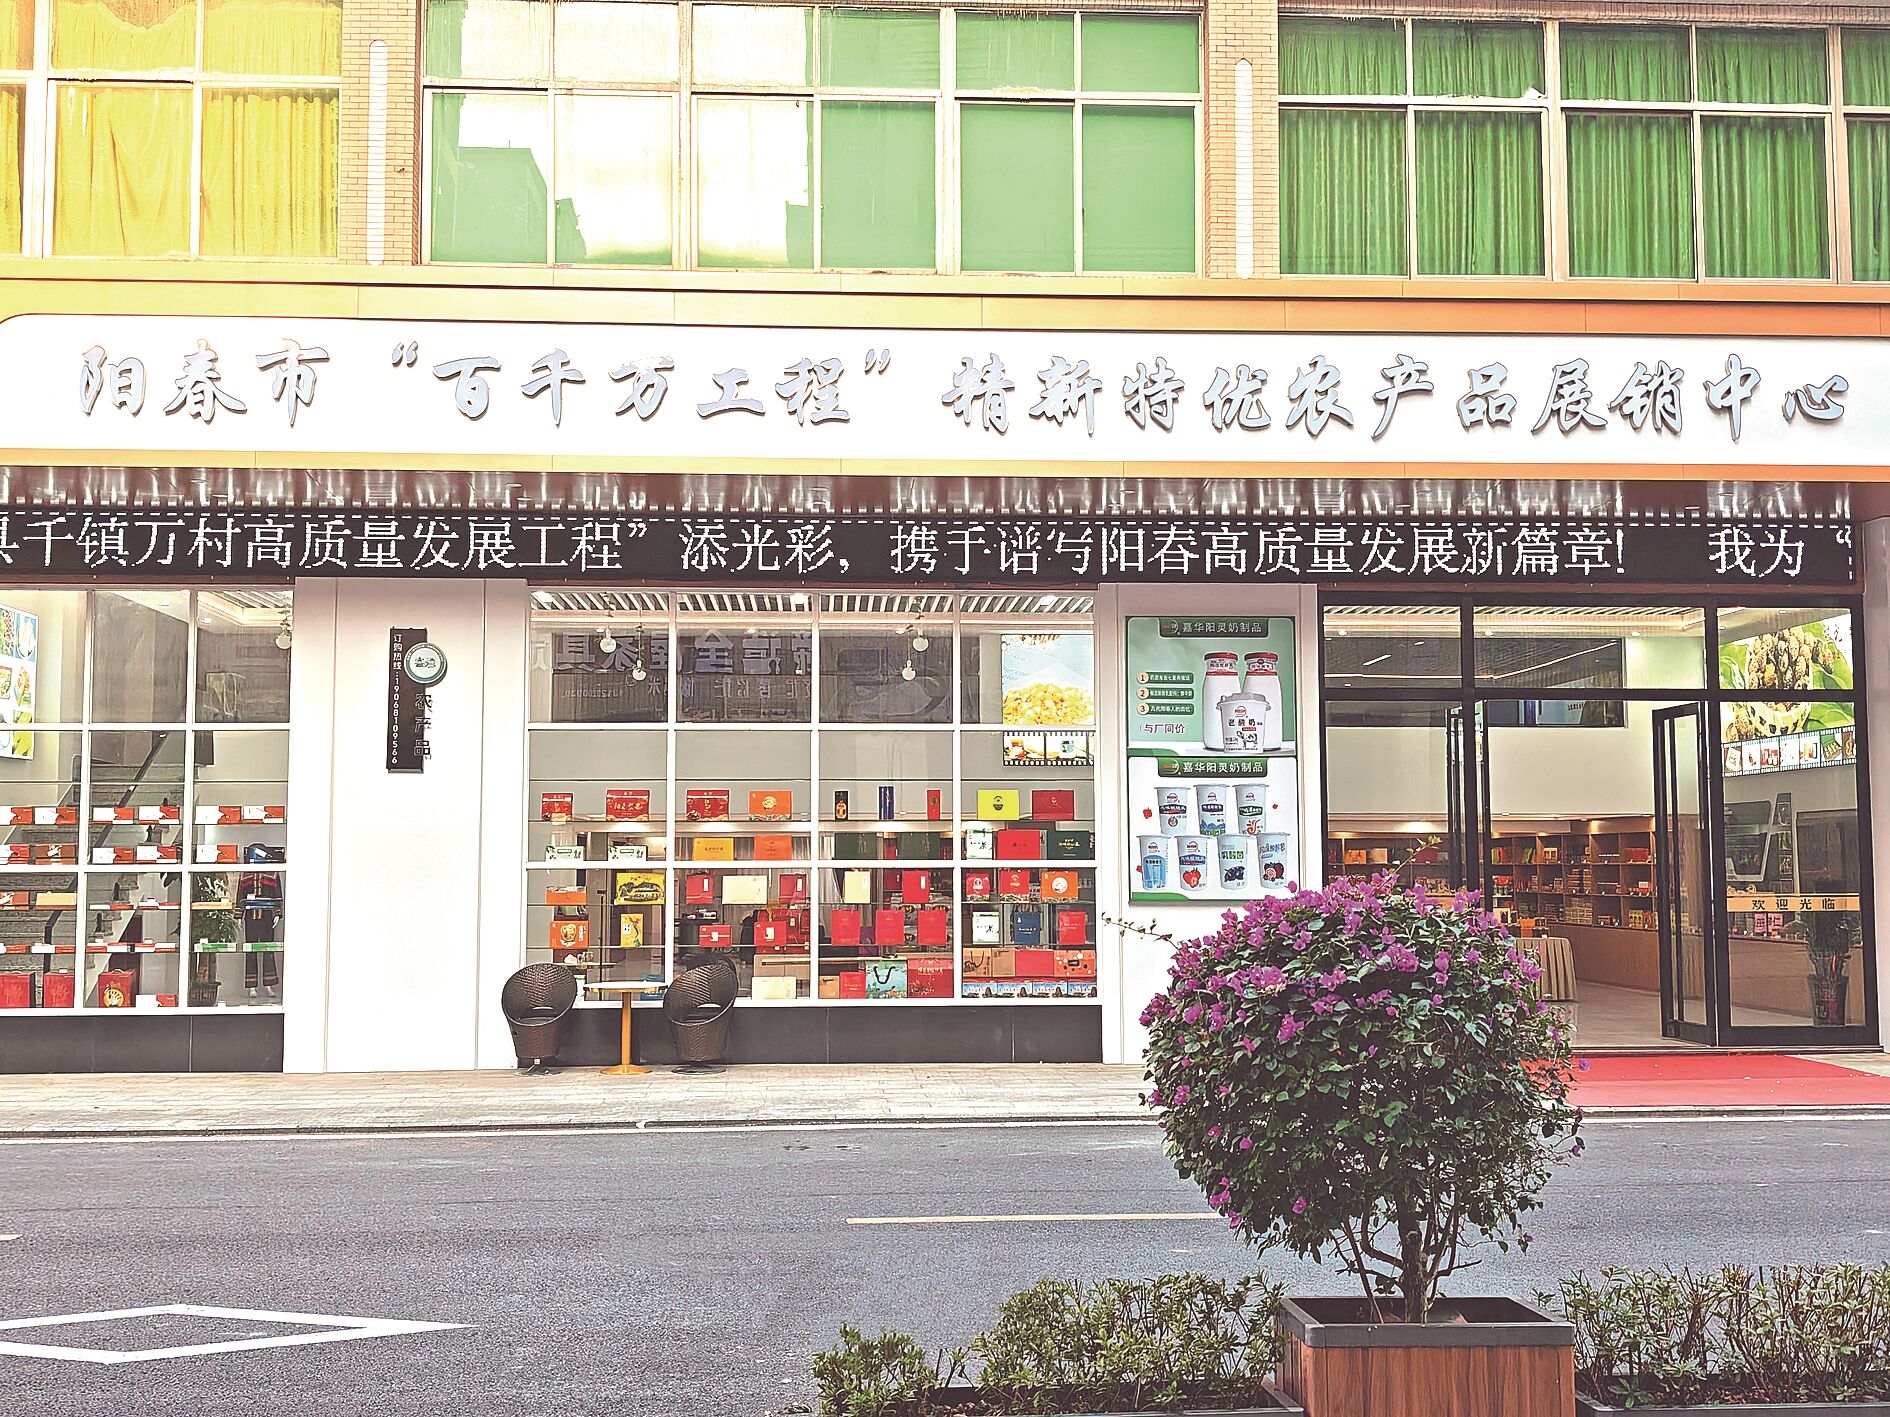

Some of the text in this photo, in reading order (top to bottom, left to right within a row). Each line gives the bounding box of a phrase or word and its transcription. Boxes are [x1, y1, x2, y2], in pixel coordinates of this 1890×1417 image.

[414, 693, 433, 760] 农产品
[1183, 761, 1263, 773] 嘉华阳灵奶制品
[1752, 897, 1836, 911] 欢迎光临
